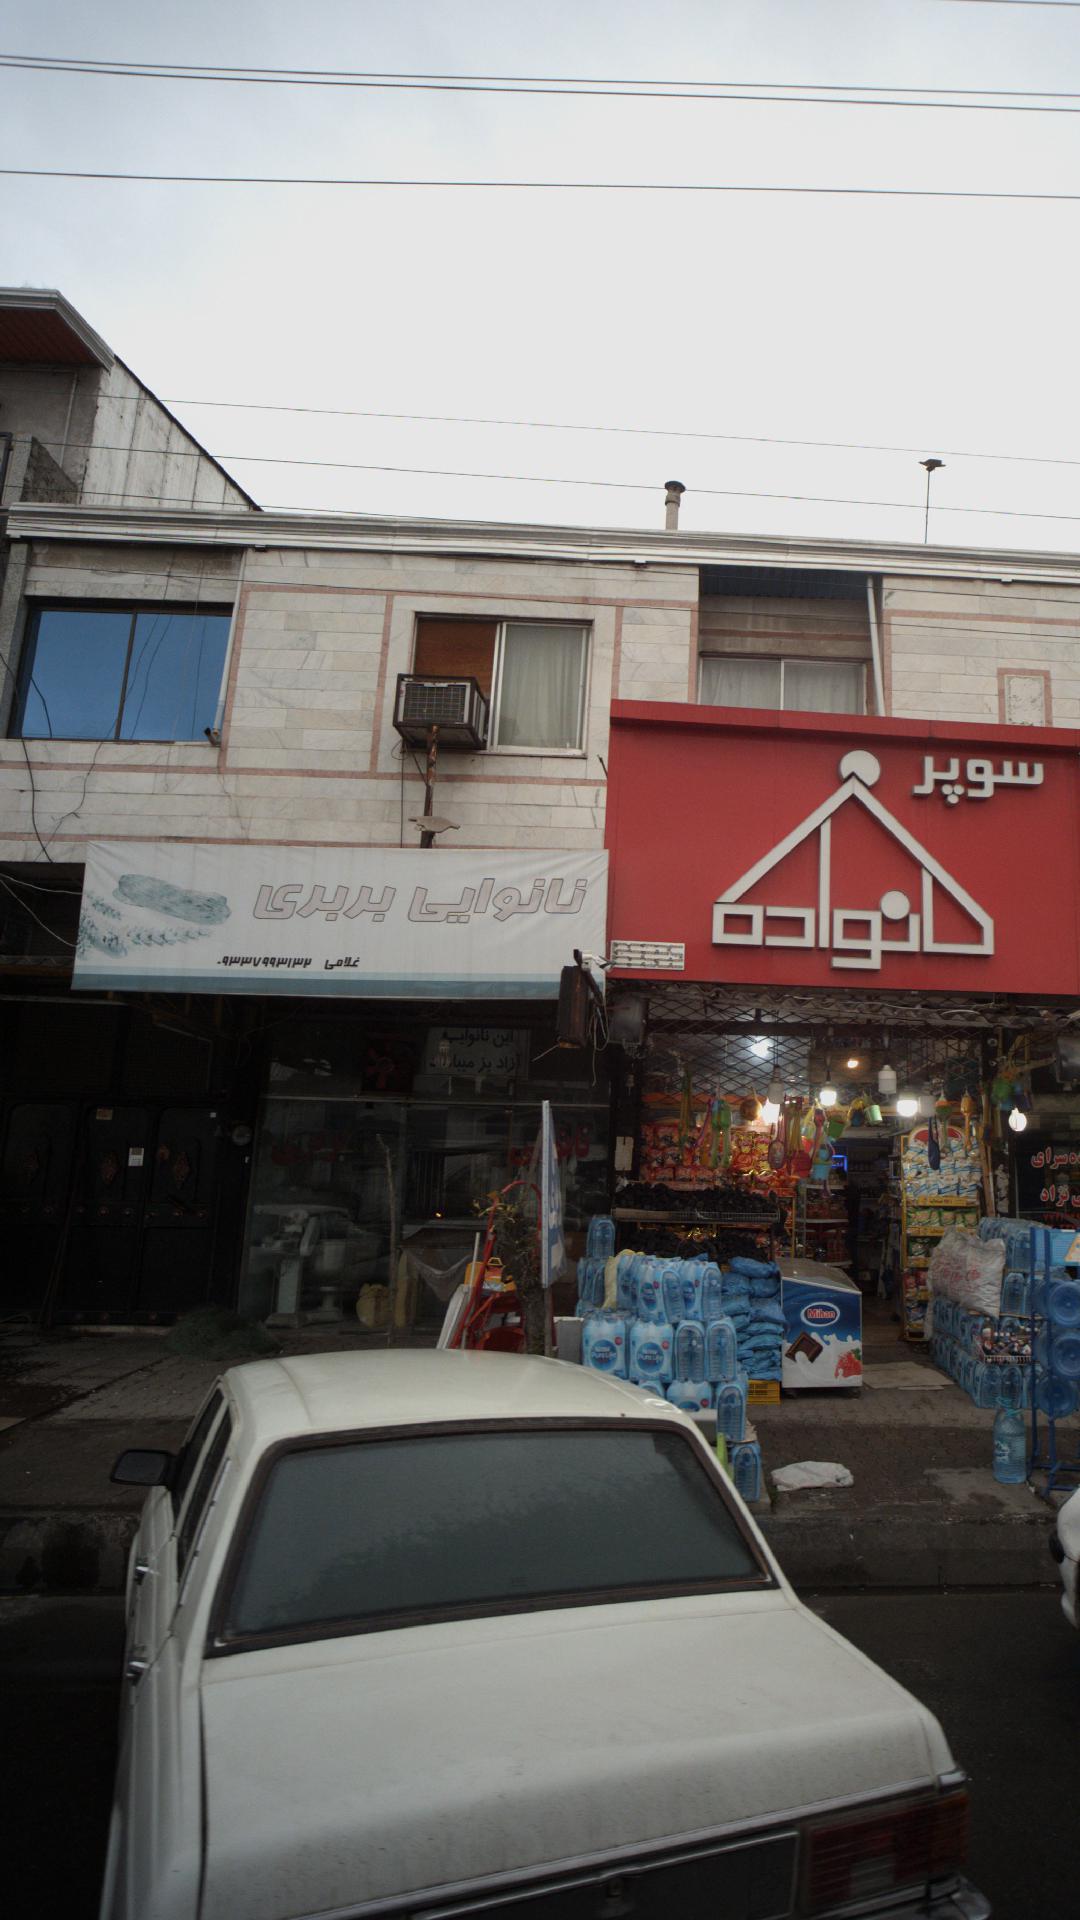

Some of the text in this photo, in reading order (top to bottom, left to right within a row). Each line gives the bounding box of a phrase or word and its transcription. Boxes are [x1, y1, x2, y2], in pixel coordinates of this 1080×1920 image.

[912, 755, 1045, 806] سوپر
[712, 749, 996, 970] خانواده
[252, 877, 588, 923] نانوایی بربری
[324, 956, 361, 970] غلامی
[493, 1030, 514, 1048] این
[806, 1308, 836, 1319] Mihan
